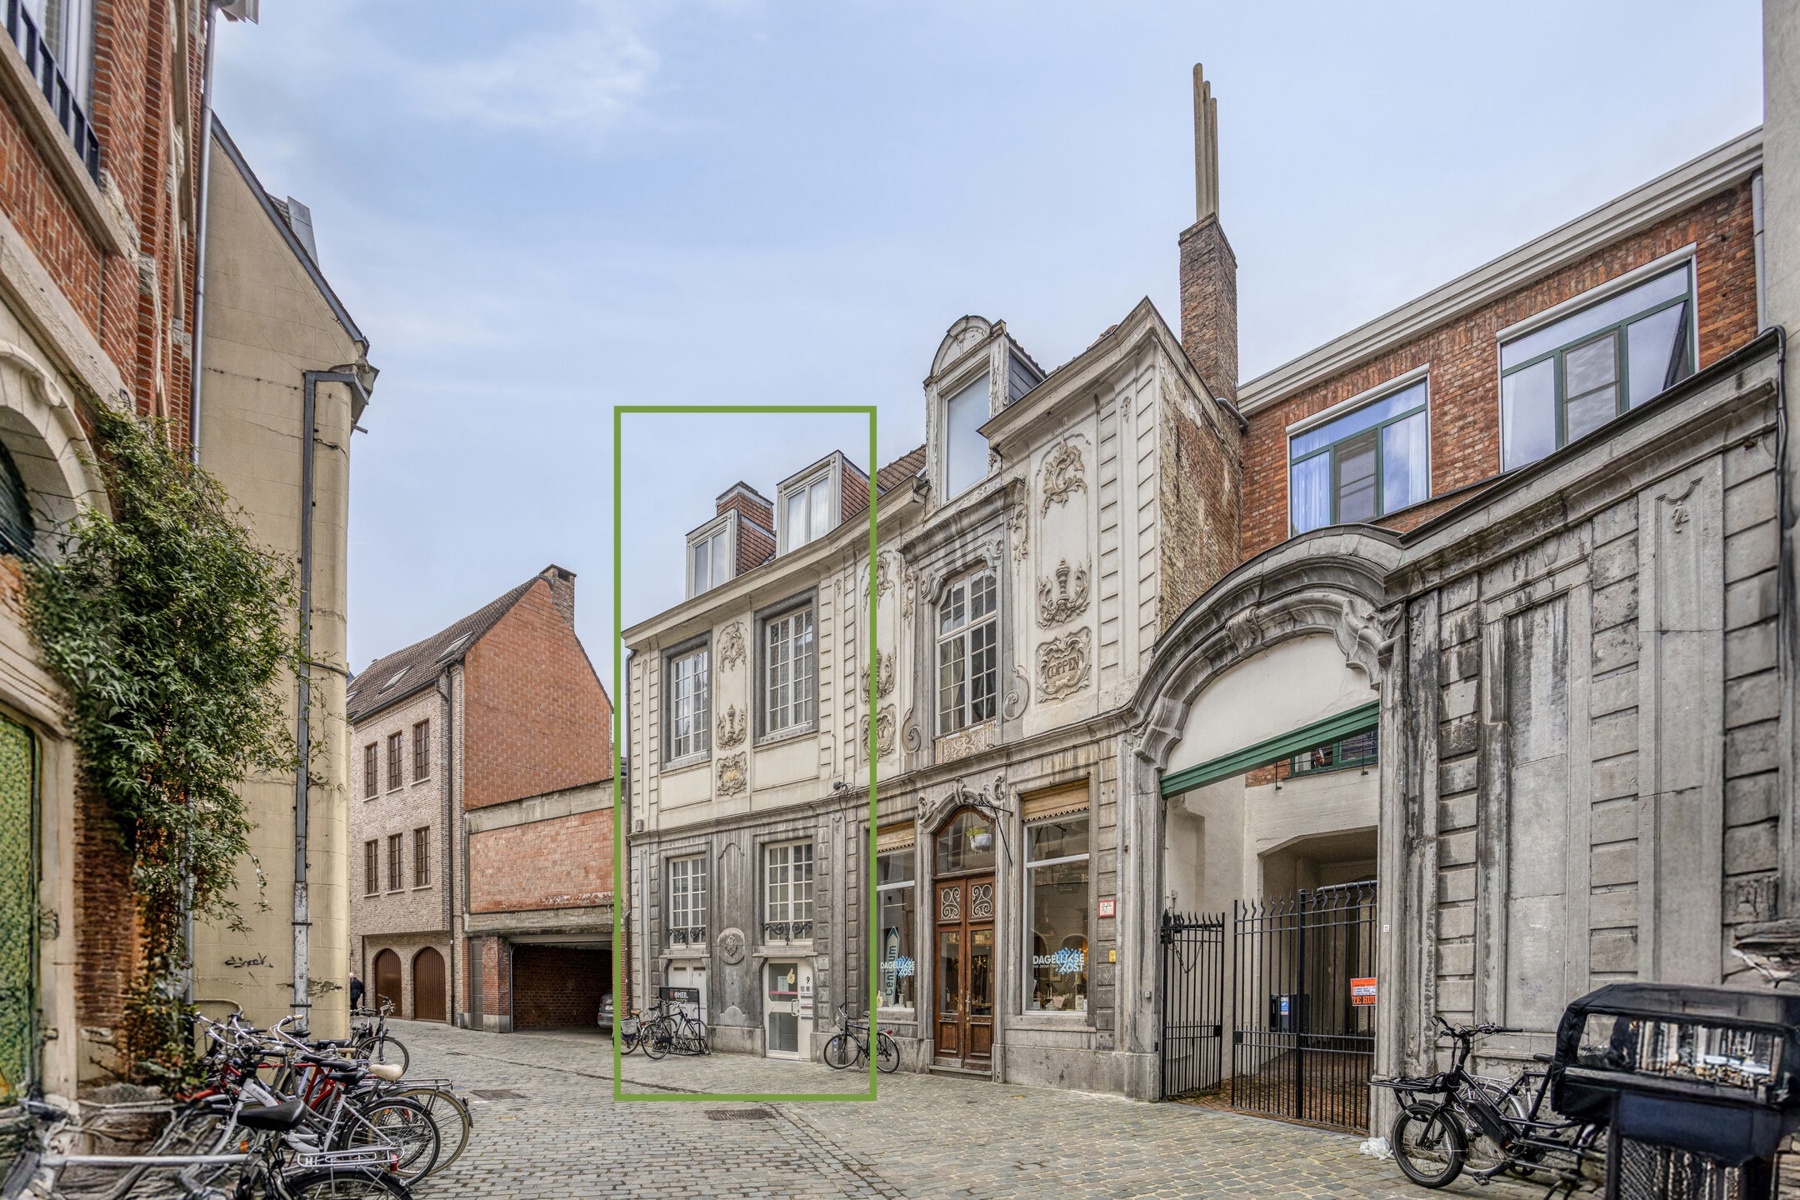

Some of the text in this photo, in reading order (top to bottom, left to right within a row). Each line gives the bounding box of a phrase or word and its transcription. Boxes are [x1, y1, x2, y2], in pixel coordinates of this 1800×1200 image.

[1046, 655, 1080, 679] COPPEN
[1032, 953, 1085, 965] DAGELIJKSE
[885, 945, 897, 996] Centum
[1061, 963, 1085, 972] KOST
[806, 976, 811, 984] 9
